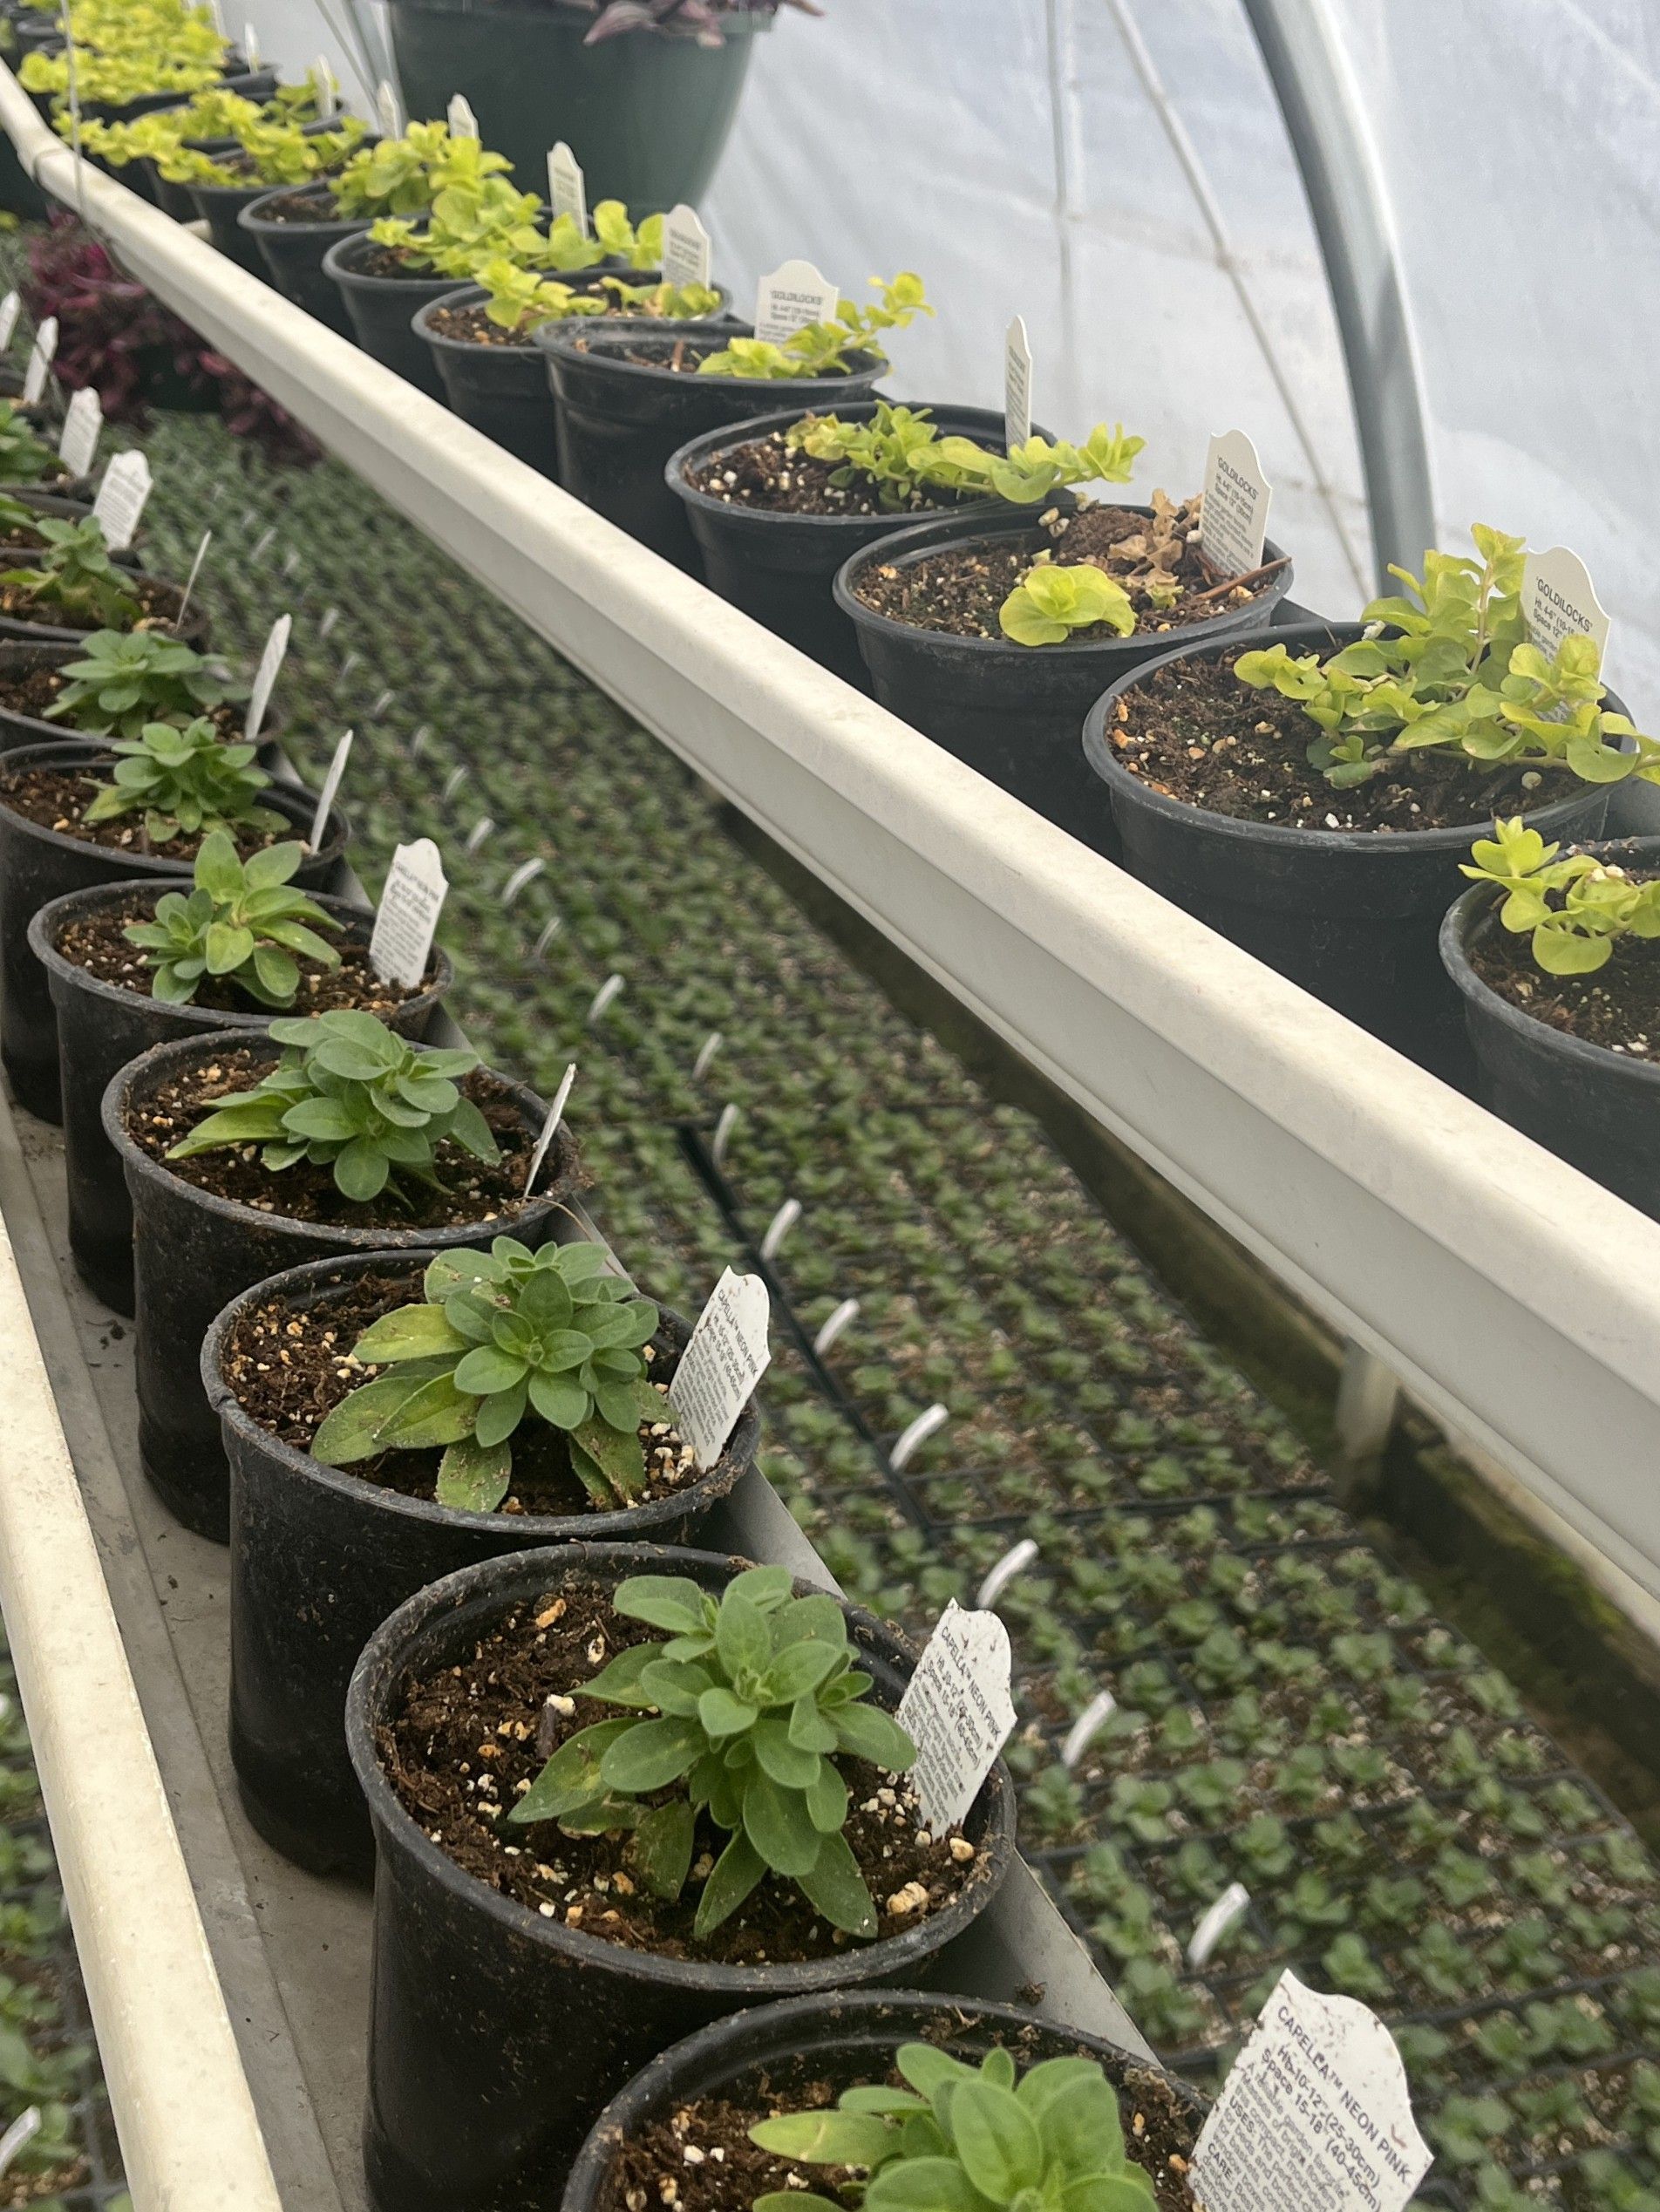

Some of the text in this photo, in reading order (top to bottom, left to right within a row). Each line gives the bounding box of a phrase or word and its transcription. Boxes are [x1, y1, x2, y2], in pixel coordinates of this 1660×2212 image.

[969, 1679, 986, 1714] NEON
[984, 1711, 1001, 1741] PINK
[1229, 2095, 1256, 2137] USES:
[1258, 2134, 1271, 2161] The
[1235, 2124, 1255, 2155] beds
[1255, 2155, 1271, 2179] and
[1262, 2047, 1292, 2095] Space
[1326, 2137, 1380, 2210] (40-45cm)
[1326, 2111, 1379, 2188] (25-30cm)
[1340, 2090, 1378, 2141] NEON
[1377, 2137, 1409, 2183] PINK
